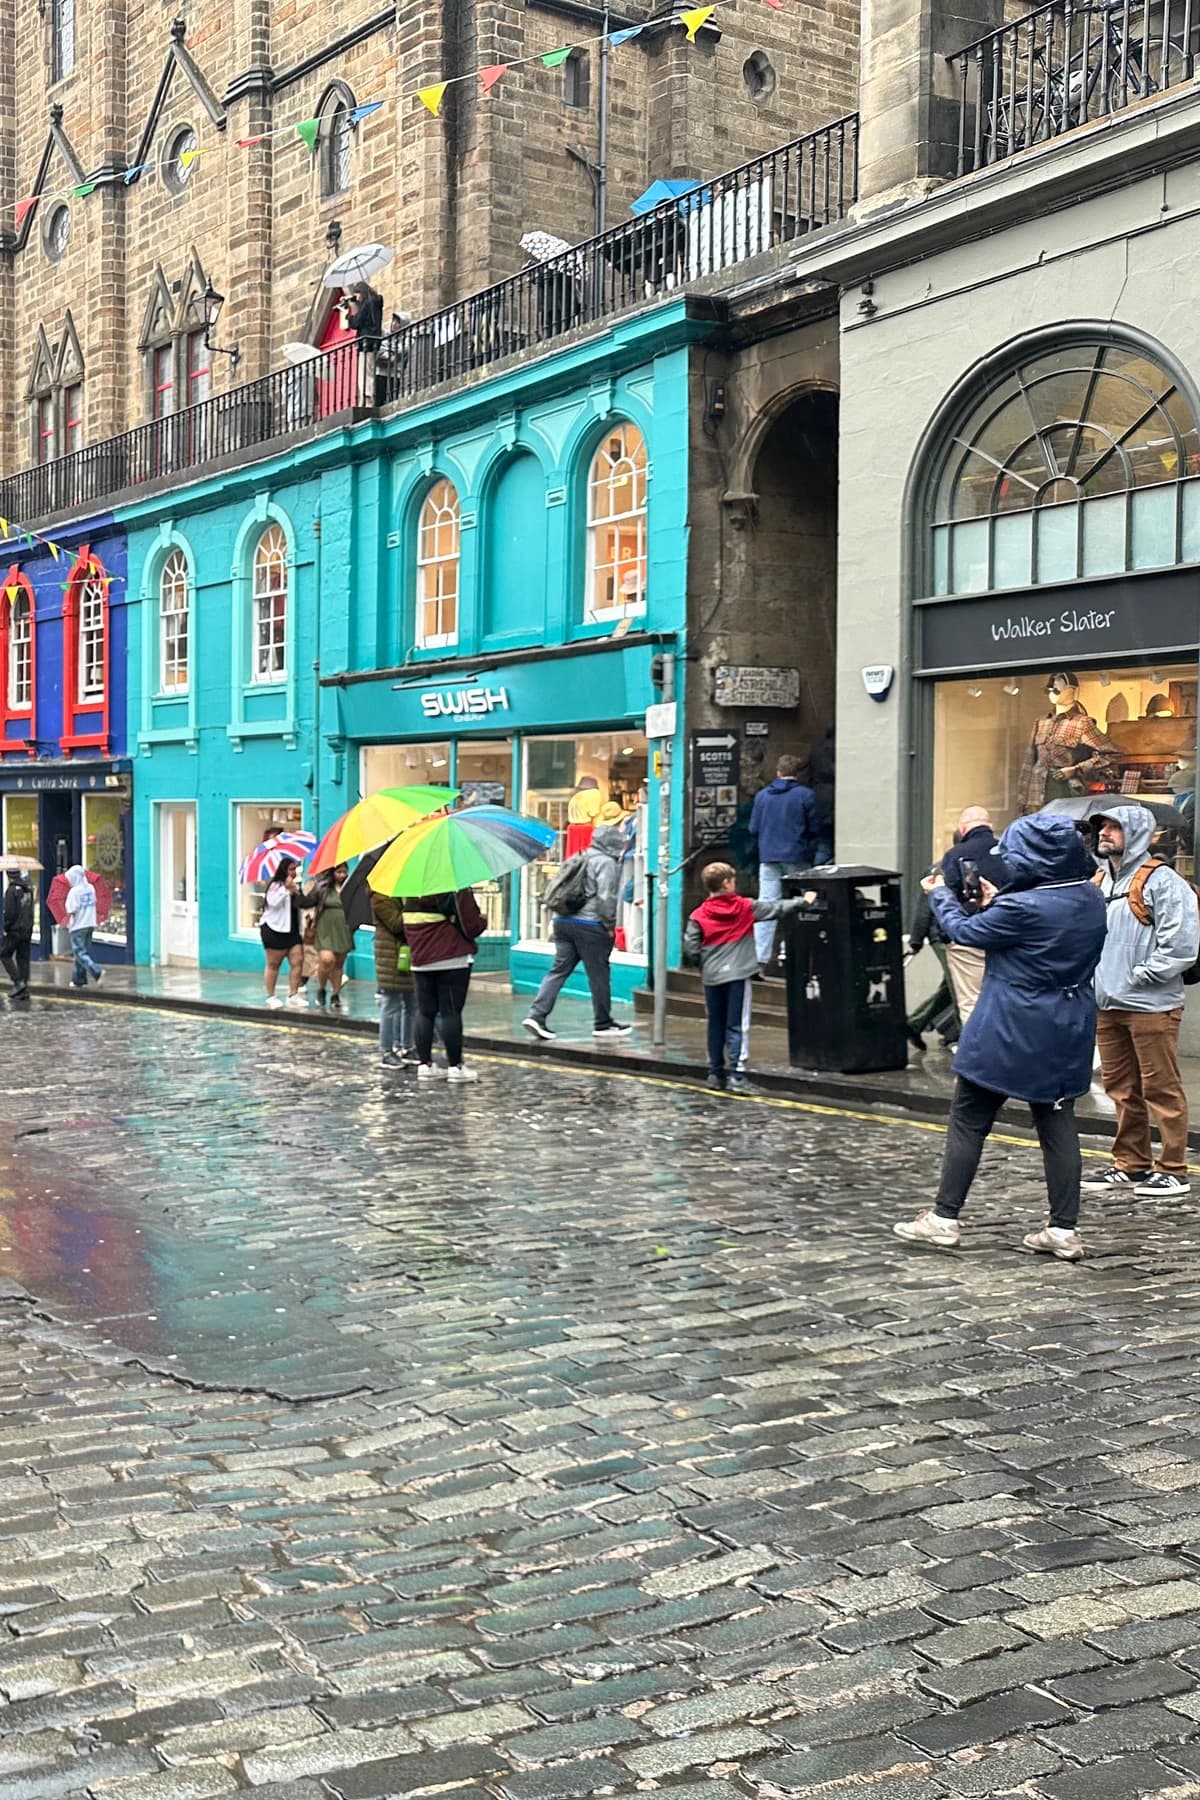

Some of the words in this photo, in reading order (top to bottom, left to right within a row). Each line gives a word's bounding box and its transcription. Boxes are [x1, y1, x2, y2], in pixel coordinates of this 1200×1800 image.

[991, 616, 1055, 641] Walker
[1060, 610, 1116, 633] Slater
[421, 686, 509, 717] SWISH
[700, 751, 732, 761] SCOTTS
